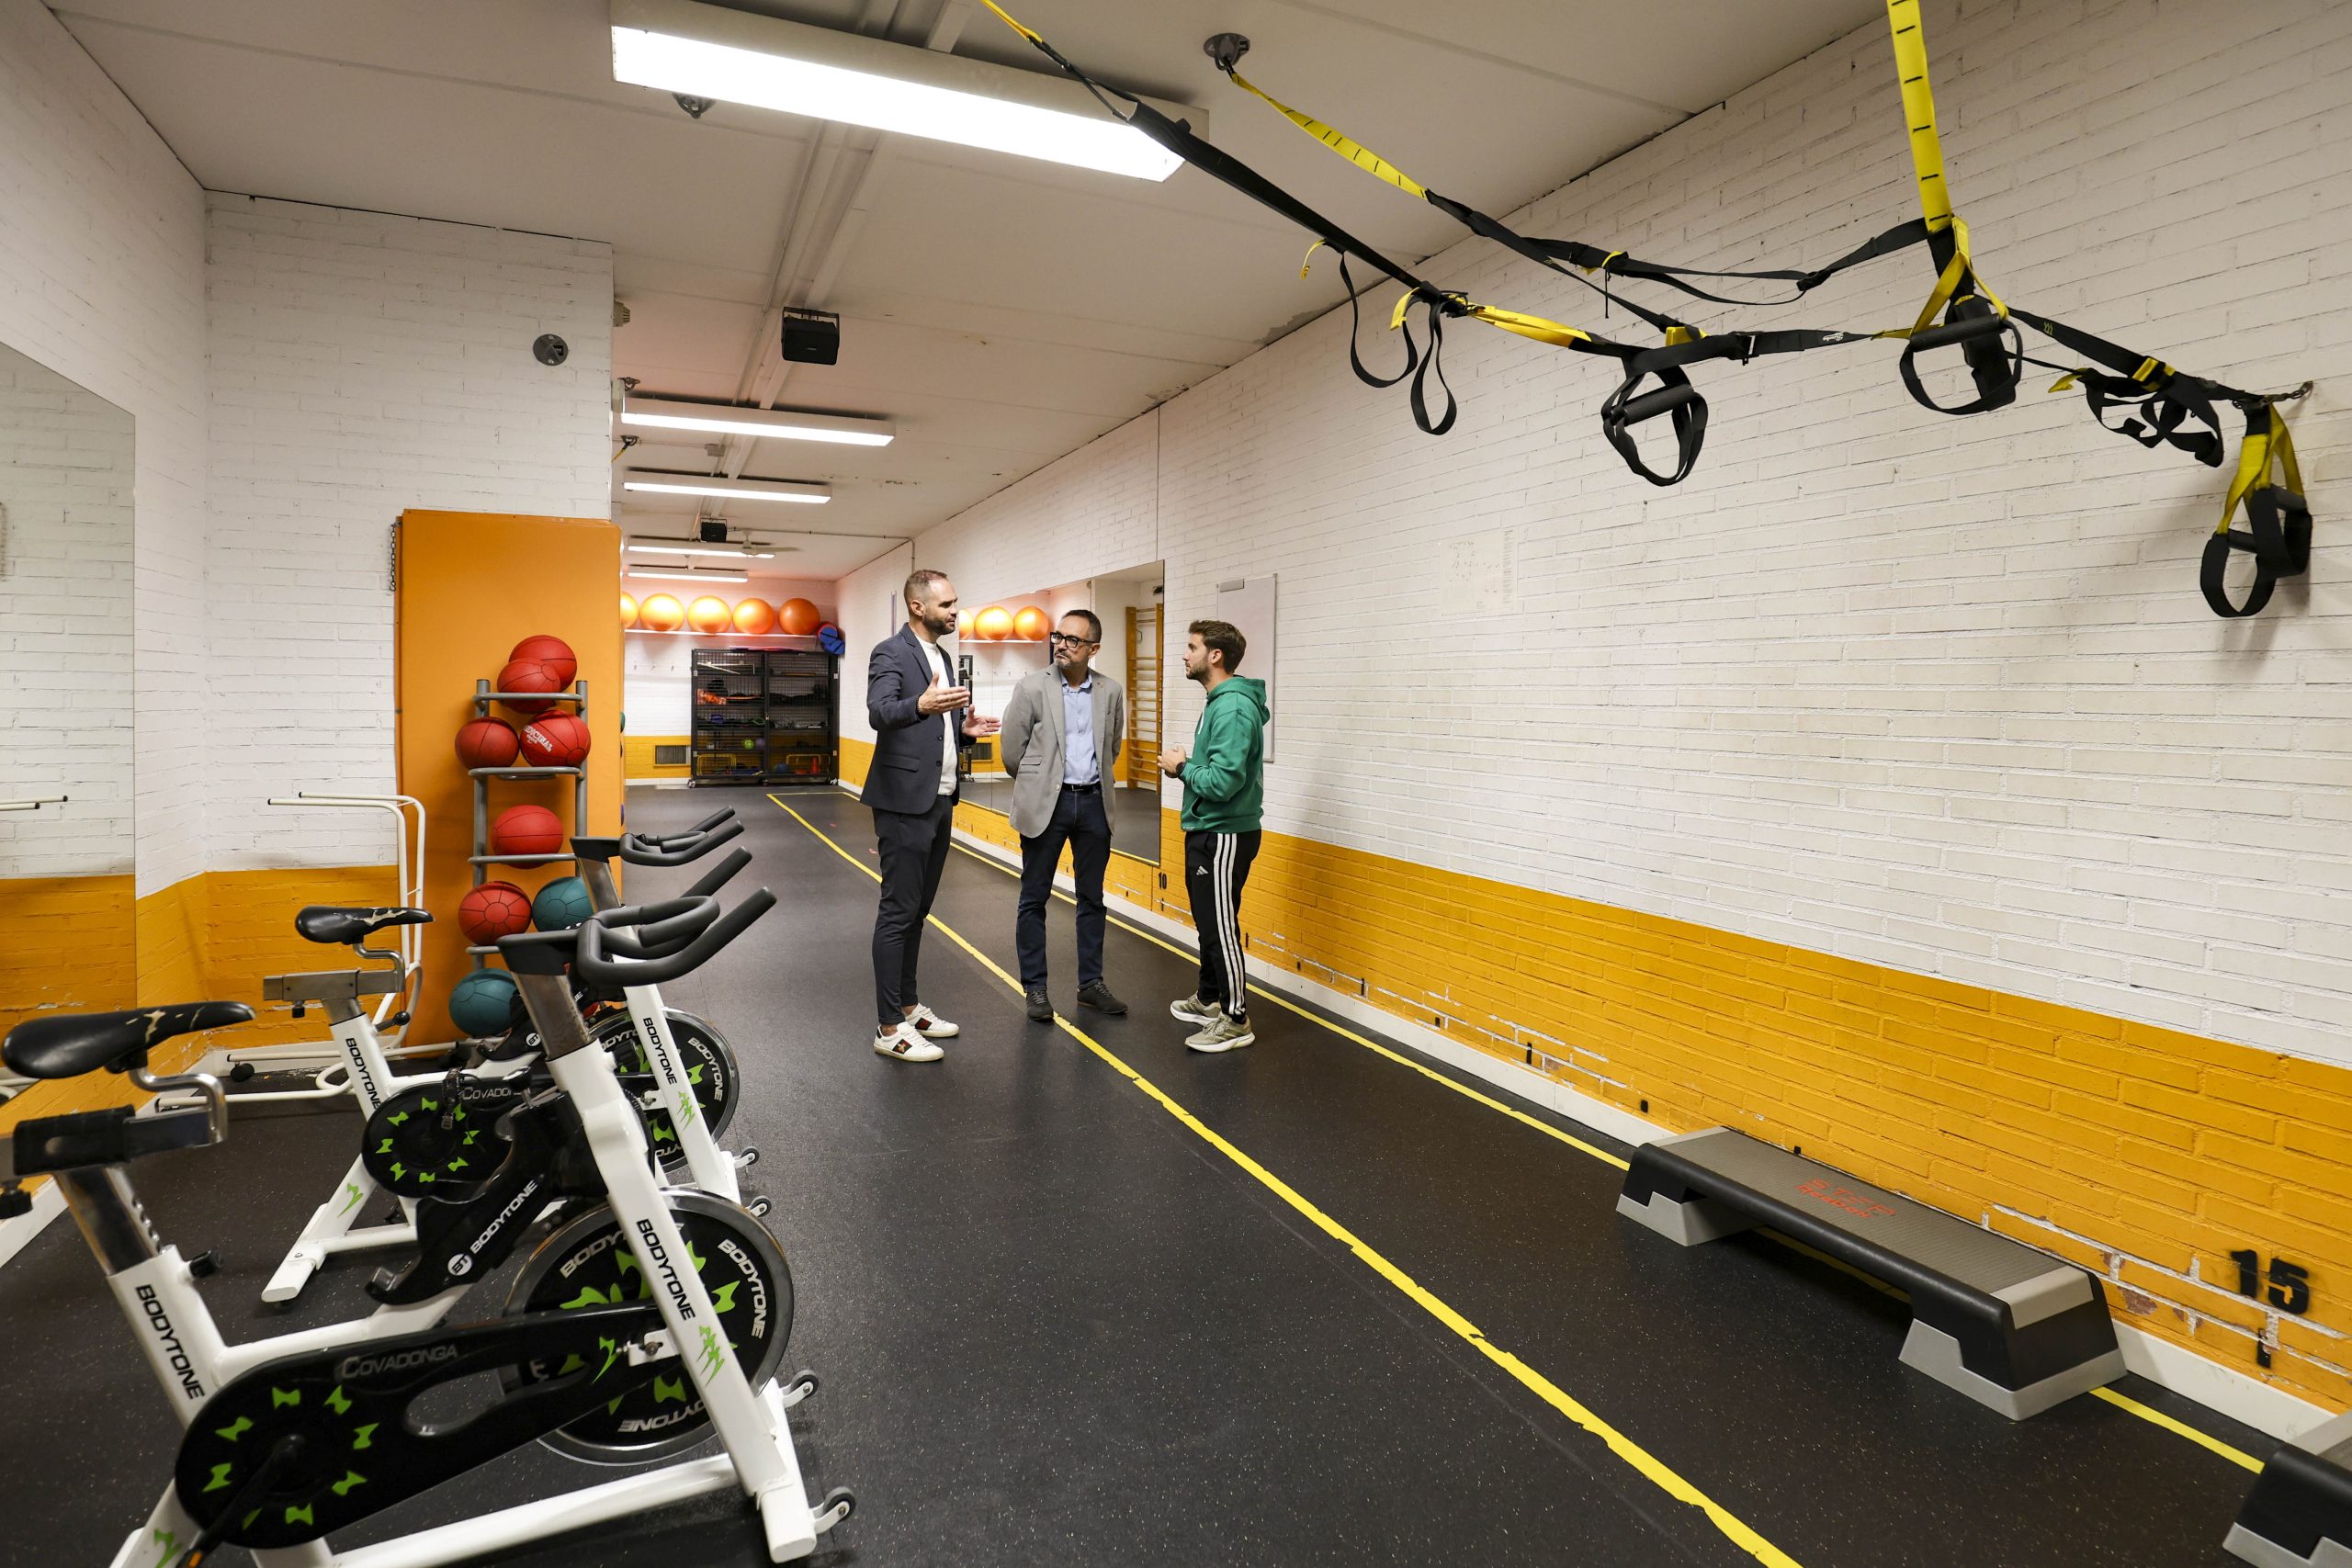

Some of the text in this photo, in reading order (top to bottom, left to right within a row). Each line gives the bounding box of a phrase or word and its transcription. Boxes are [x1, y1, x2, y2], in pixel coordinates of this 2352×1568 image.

[1159, 872, 1167, 890] 10
[643, 1017, 678, 1085] BODYTONE
[687, 1037, 724, 1101] BODYTONE
[461, 1087, 512, 1100] COVADO
[470, 1180, 538, 1255] BODYTONE
[636, 1219, 696, 1321] BODYTONE
[718, 1239, 767, 1339] BODYTONE
[2230, 1249, 2308, 1314] 15
[135, 1284, 206, 1400] BODYTONE
[342, 1344, 458, 1379] COVADONGA
